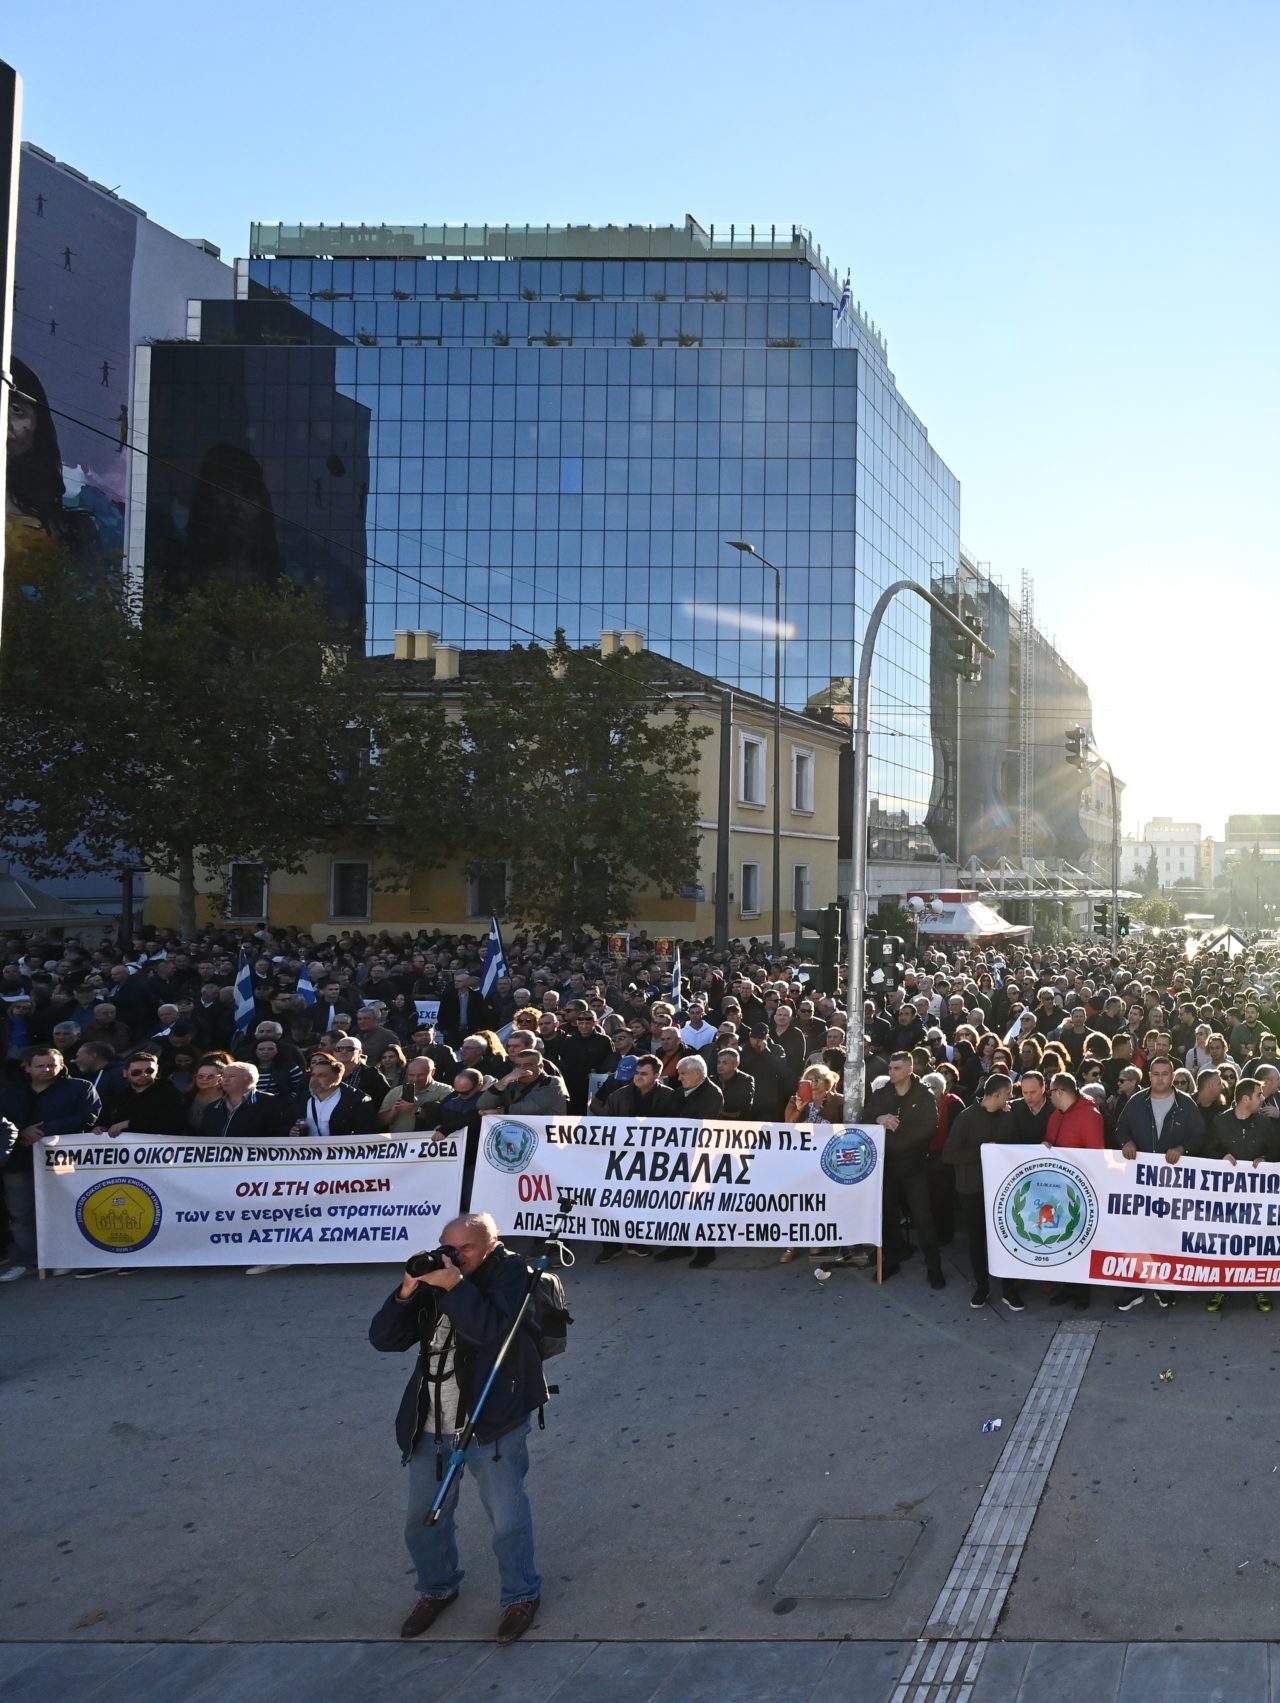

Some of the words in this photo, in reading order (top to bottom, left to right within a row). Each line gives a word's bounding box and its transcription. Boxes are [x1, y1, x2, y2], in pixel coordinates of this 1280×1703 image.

[545, 1124, 617, 1146] ΕΝΩΣΗ
[623, 1126, 772, 1150] ΣΤΡΑΤΙΩΤΙΚΩΝ
[778, 1130, 818, 1151] Π.Ε.
[45, 1147, 130, 1167] ΣΩΜΑΤΕΙΟ
[133, 1145, 244, 1165] ΟΙΚΟΓΕΝΕΙΩΝ
[246, 1146, 323, 1162] ΕΝΟΠΛΩΝ
[326, 1142, 409, 1161] ΔΥΝΑΜΕΩΝ
[417, 1141, 458, 1159] ΣΟΕΔ
[604, 1150, 755, 1185] ΚΑΒΑΛΑΣ
[1024, 1162, 1076, 1177] ΠΕΡΙΦΕΡΕΙΑΚΗΣ
[1136, 1163, 1197, 1190] ΕΝΩΣΗ
[235, 1182, 268, 1198] ΟΧΙ
[272, 1181, 310, 1197] ΣΤΗ
[313, 1178, 391, 1195] ΦΙΜΩΣΗ
[518, 1174, 553, 1203] ΟΧΙ
[599, 1188, 716, 1211] ΒΑΘΜΟΛΟΓΙΚΗ
[717, 1192, 826, 1213] ΜΙΣΘΟΛΟΓΙΚΗ
[997, 1170, 1025, 1215] ΣΤΡΑΤΙΩΤΙΚΩΝ
[1074, 1174, 1094, 1208] ΕΝΟΤΗΤΑΣ
[175, 1210, 210, 1223] των
[215, 1209, 236, 1222] εν
[241, 1203, 322, 1222] ενεργεία
[327, 1201, 442, 1219] στρατιωτικών
[1107, 1193, 1263, 1226] ΠΕΡΙΦΕΡΕΙΑΚΗΣ
[210, 1231, 243, 1244] στα
[248, 1227, 314, 1243] ΑΣΤΙΚΑ
[318, 1226, 409, 1242] ΣΩΜΑΤΕΙΑ
[591, 1217, 620, 1238] ΤΩΝ
[624, 1220, 691, 1242] ΘΕΣΜΩΝ
[997, 1216, 1009, 1240] ΕΝΩΣΗ
[1079, 1208, 1095, 1246] ΚΑΣΤΟΡΙΑΣ
[1101, 1256, 1138, 1278] ΟΧΙ
[1139, 1261, 1172, 1281] ΣΤΟ
[1172, 1263, 1221, 1283] ΣΩΜΑ
